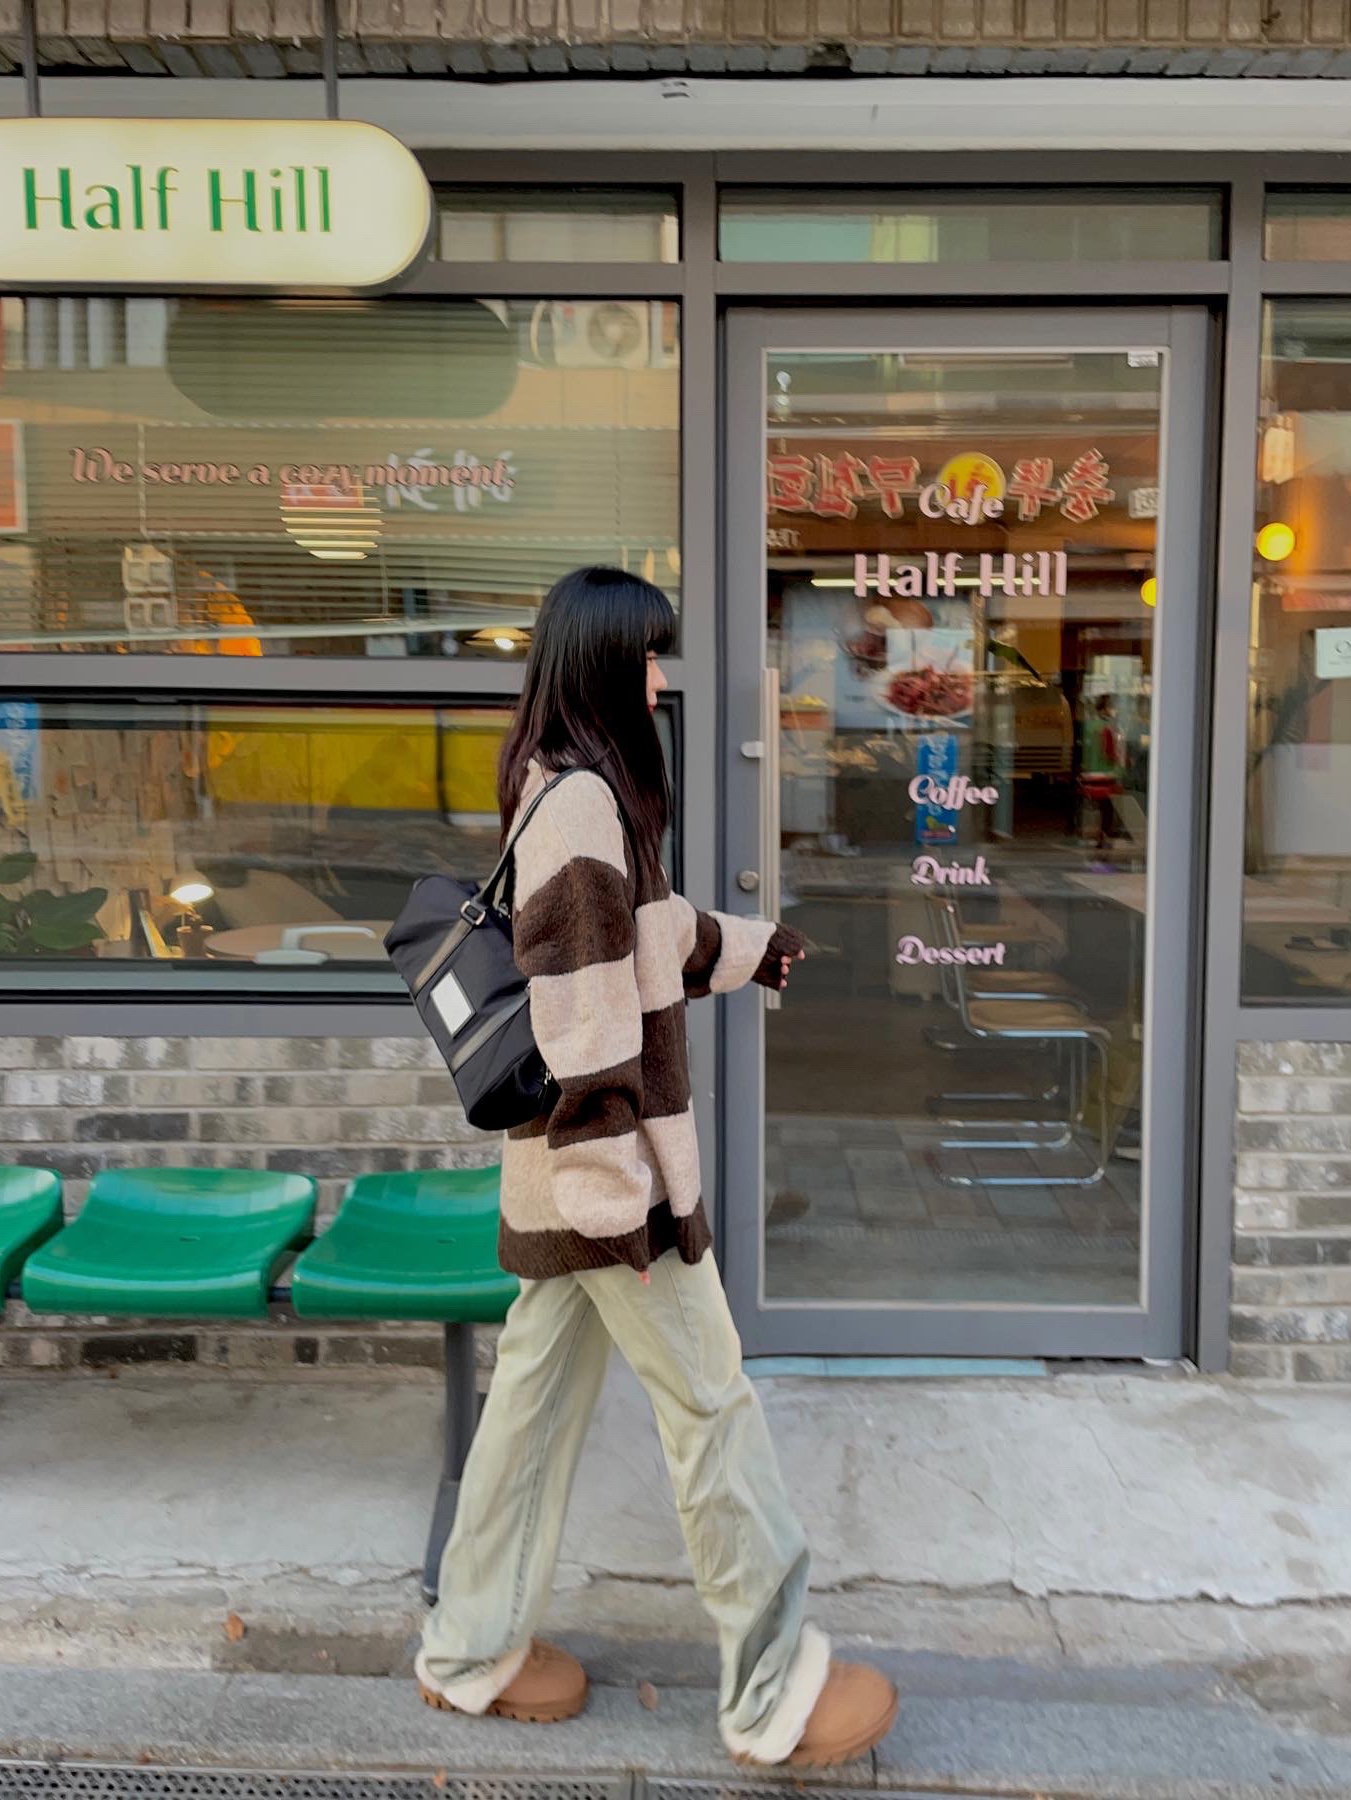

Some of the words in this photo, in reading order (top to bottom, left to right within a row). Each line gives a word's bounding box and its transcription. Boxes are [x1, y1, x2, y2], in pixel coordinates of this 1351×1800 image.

[23, 164, 179, 231] Half
[208, 165, 331, 232] Hill
[69, 447, 133, 485] We
[141, 462, 241, 485] serve
[247, 463, 271, 486] a
[279, 464, 357, 493] cozy
[919, 483, 1004, 525] Cafe
[854, 551, 964, 597] Half
[980, 551, 1067, 597] Hill
[908, 774, 999, 810] Coffee
[911, 855, 991, 885] Drink
[896, 935, 1006, 965] Dessert
